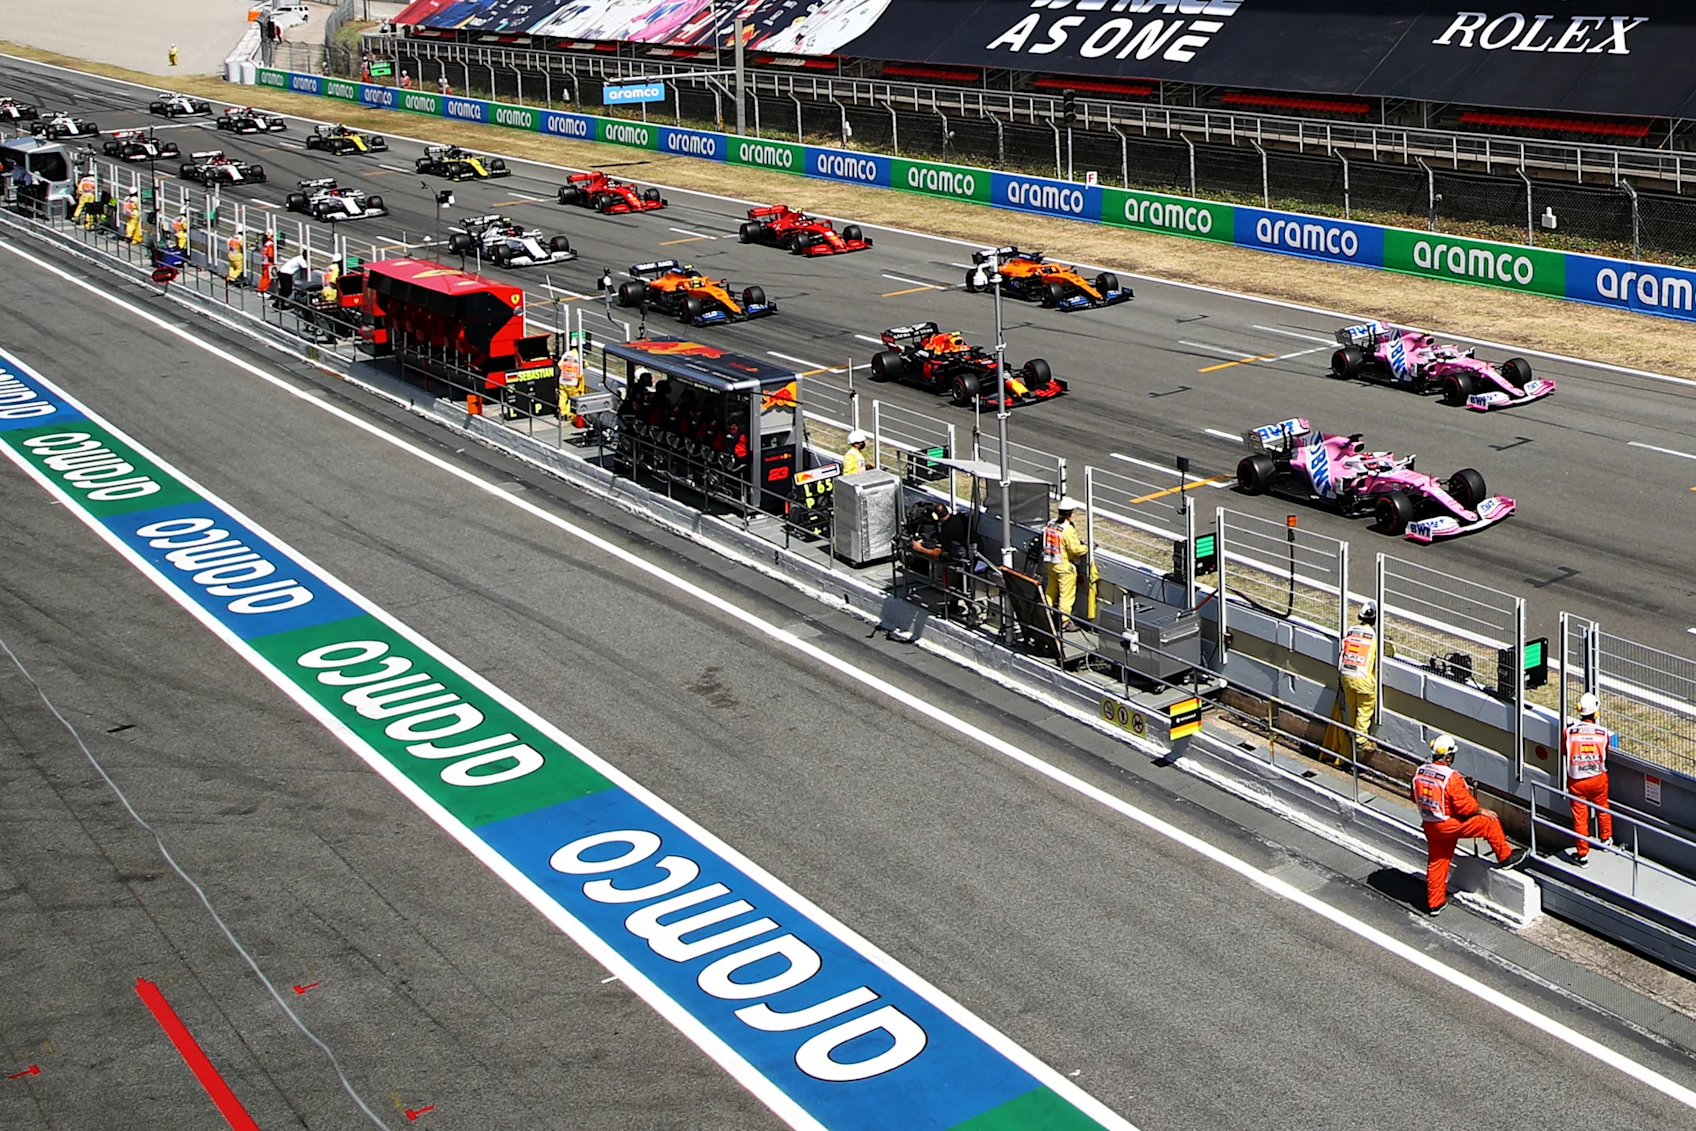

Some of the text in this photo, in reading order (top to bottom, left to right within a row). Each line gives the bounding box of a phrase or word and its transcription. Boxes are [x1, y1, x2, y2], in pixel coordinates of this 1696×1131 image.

[986, 13, 1224, 63] AS ONE
[1432, 11, 1649, 55] ROLEX
[404, 95, 435, 113] aramco
[608, 87, 660, 101] aramco
[447, 101, 481, 120] aramco
[496, 108, 532, 128] aramco
[547, 115, 587, 137] aramco
[604, 123, 649, 147] aramco
[667, 132, 716, 157] aramco
[738, 142, 793, 169] aramco
[817, 153, 877, 181] aramco
[1086, 172, 1093, 183] F
[907, 166, 975, 196] aramco
[1007, 180, 1084, 214] aramco
[1123, 197, 1213, 234] aramco
[1254, 217, 1359, 257] aramco
[1412, 240, 1534, 286] aramco
[518, 367, 555, 382] SEBASTIAN
[535, 403, 542, 414] P
[1470, 394, 1487, 407] BWT
[23, 431, 163, 502] aramco
[768, 466, 790, 482] 23
[804, 478, 834, 497] L 65
[805, 497, 816, 509] P
[1410, 524, 1431, 537] BWT
[135, 517, 315, 615] aramco
[296, 639, 546, 788] aramco
[548, 828, 928, 1083] aramco
